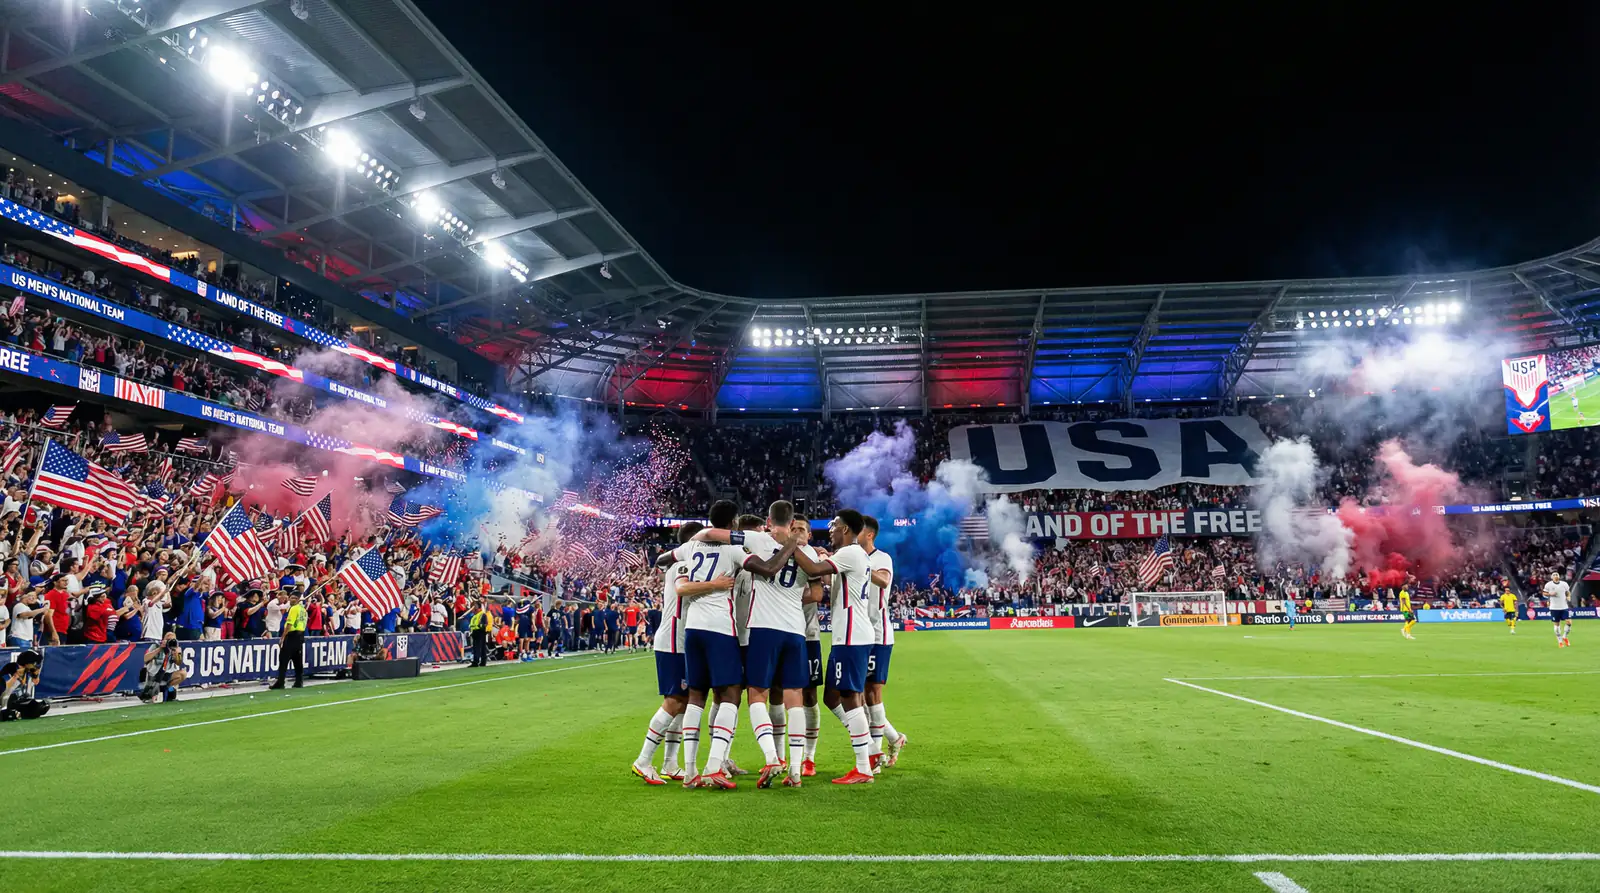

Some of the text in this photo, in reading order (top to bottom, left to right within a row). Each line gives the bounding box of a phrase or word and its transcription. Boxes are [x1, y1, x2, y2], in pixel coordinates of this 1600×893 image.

[11, 272, 125, 320] US MEN'S NATIONAL TEAM
[216, 289, 283, 327] LAND OF THE FREE
[1512, 360, 1537, 375] USA
[201, 404, 212, 417] US
[966, 420, 1270, 485] USA
[1024, 510, 1263, 537] AND OF THE FREE
[690, 551, 720, 583] 27
[1162, 615, 1208, 627] Continental
[200, 645, 225, 677] US
[228, 642, 309, 675] NATIOL
[311, 640, 348, 667] TEAM
[808, 658, 820, 675] 12
[835, 661, 842, 679] 8
